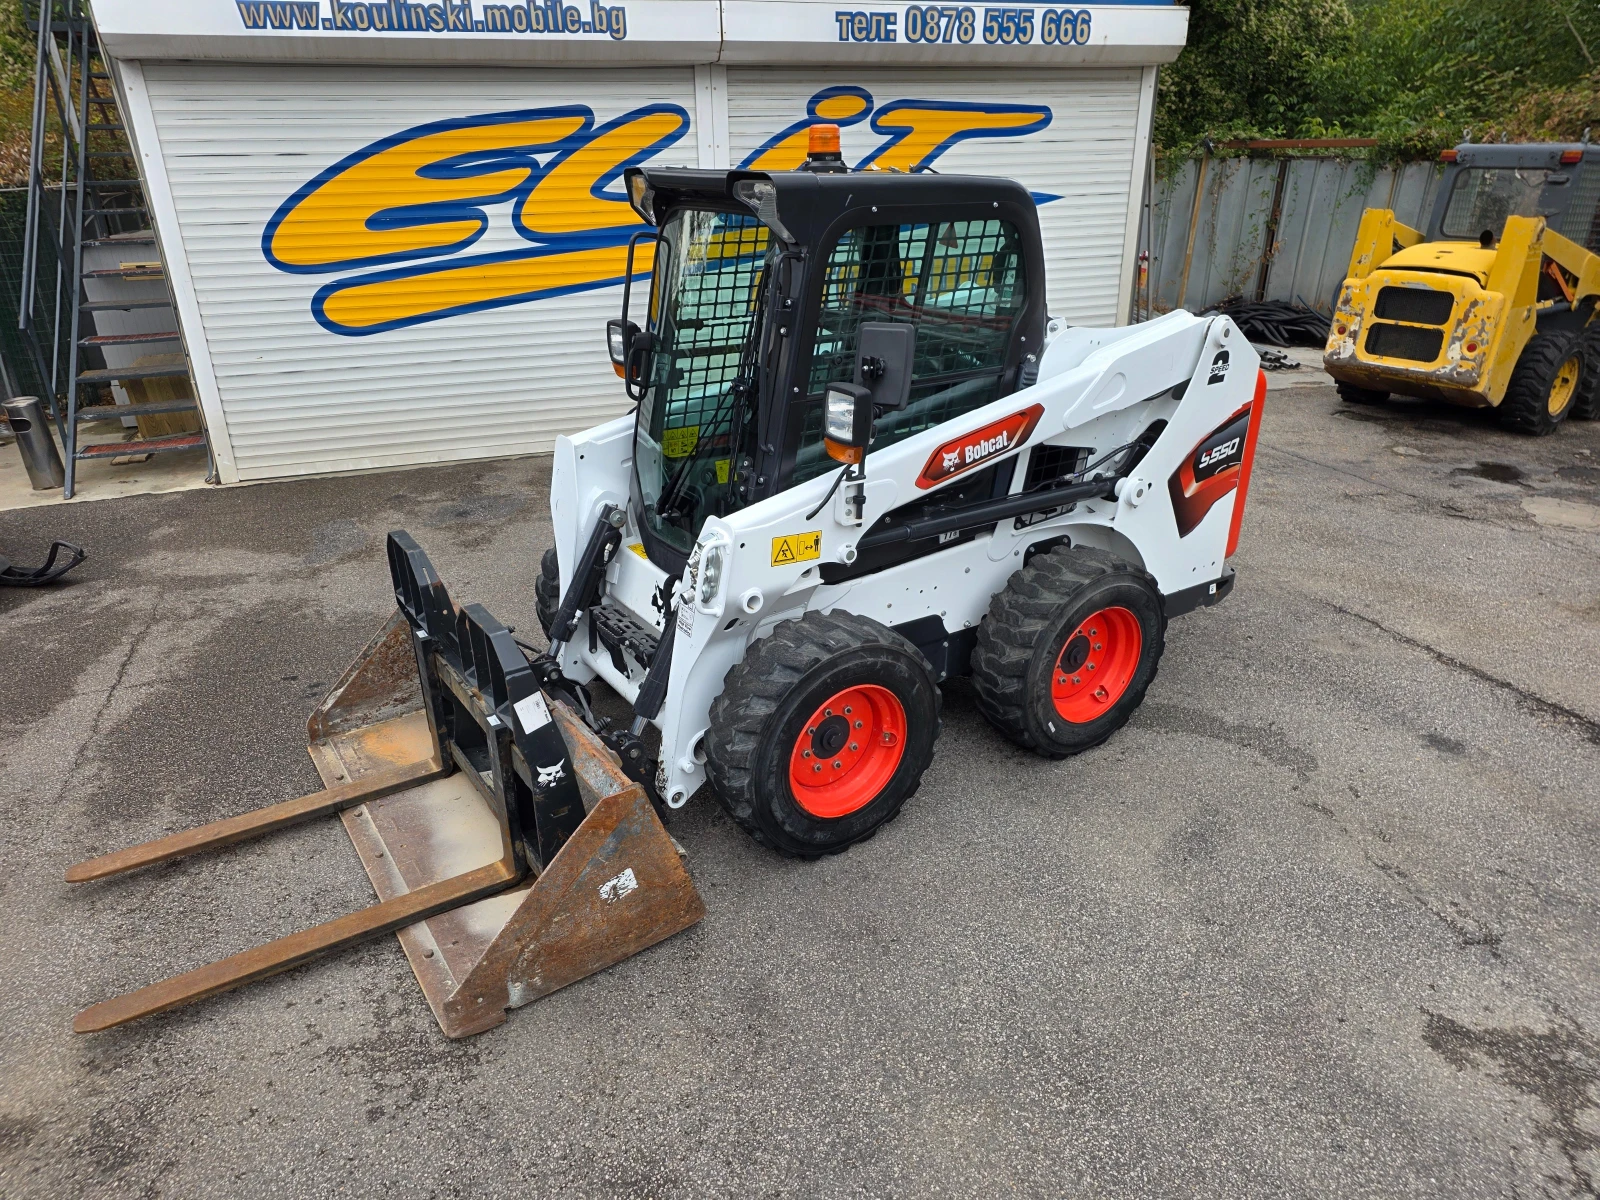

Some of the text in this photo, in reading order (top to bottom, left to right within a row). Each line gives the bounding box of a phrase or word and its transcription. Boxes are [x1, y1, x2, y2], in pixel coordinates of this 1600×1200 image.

[237, 0, 627, 40] www.koulinski.mobile.bg
[836, 5, 1092, 45] тел: 0878 555 666
[1209, 364, 1230, 374] SPEED
[964, 430, 1008, 464] Bobcat
[1199, 437, 1240, 469] S550
